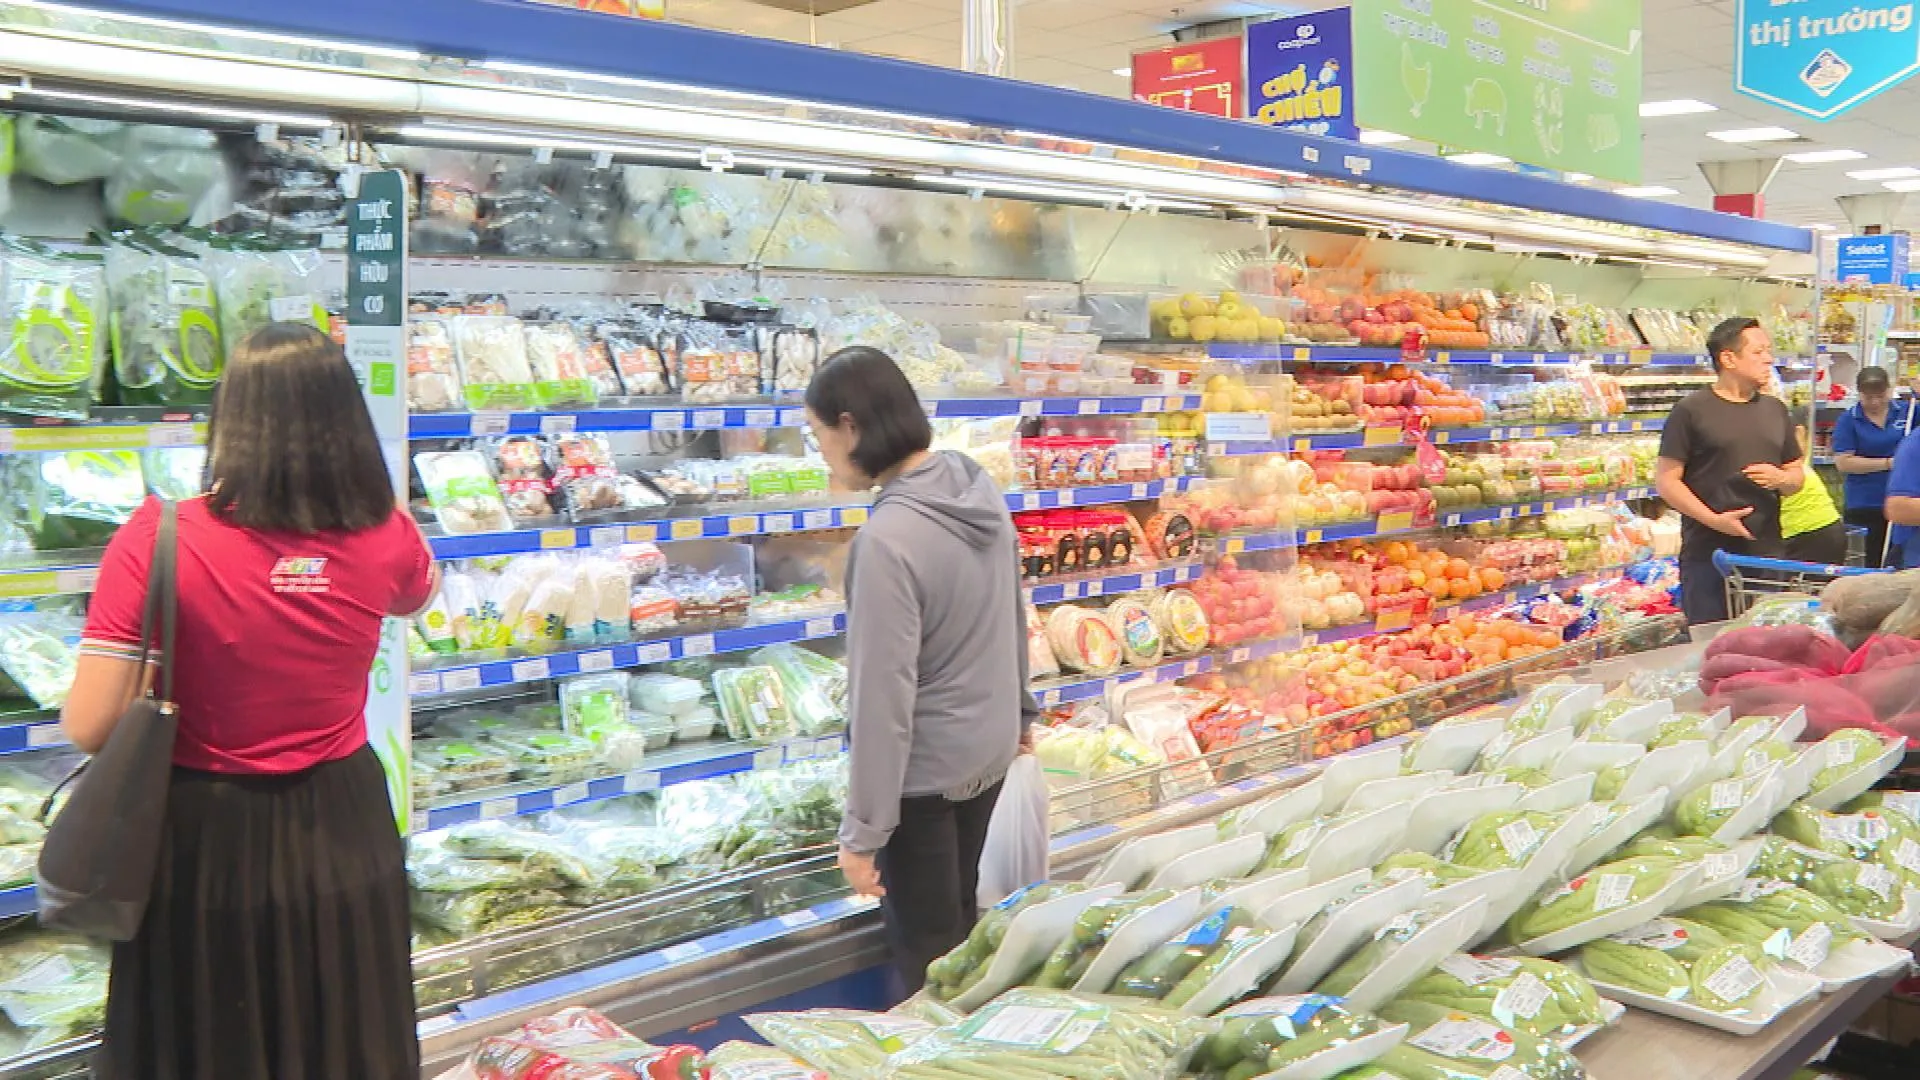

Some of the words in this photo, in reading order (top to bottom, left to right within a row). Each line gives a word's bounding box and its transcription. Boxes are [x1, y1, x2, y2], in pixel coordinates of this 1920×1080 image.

[1750, 18, 1791, 47] thị
[1799, 4, 1913, 38] trường
[357, 198, 393, 225] THỰC
[355, 225, 394, 252] PHẨM
[359, 259, 389, 283] HỮU
